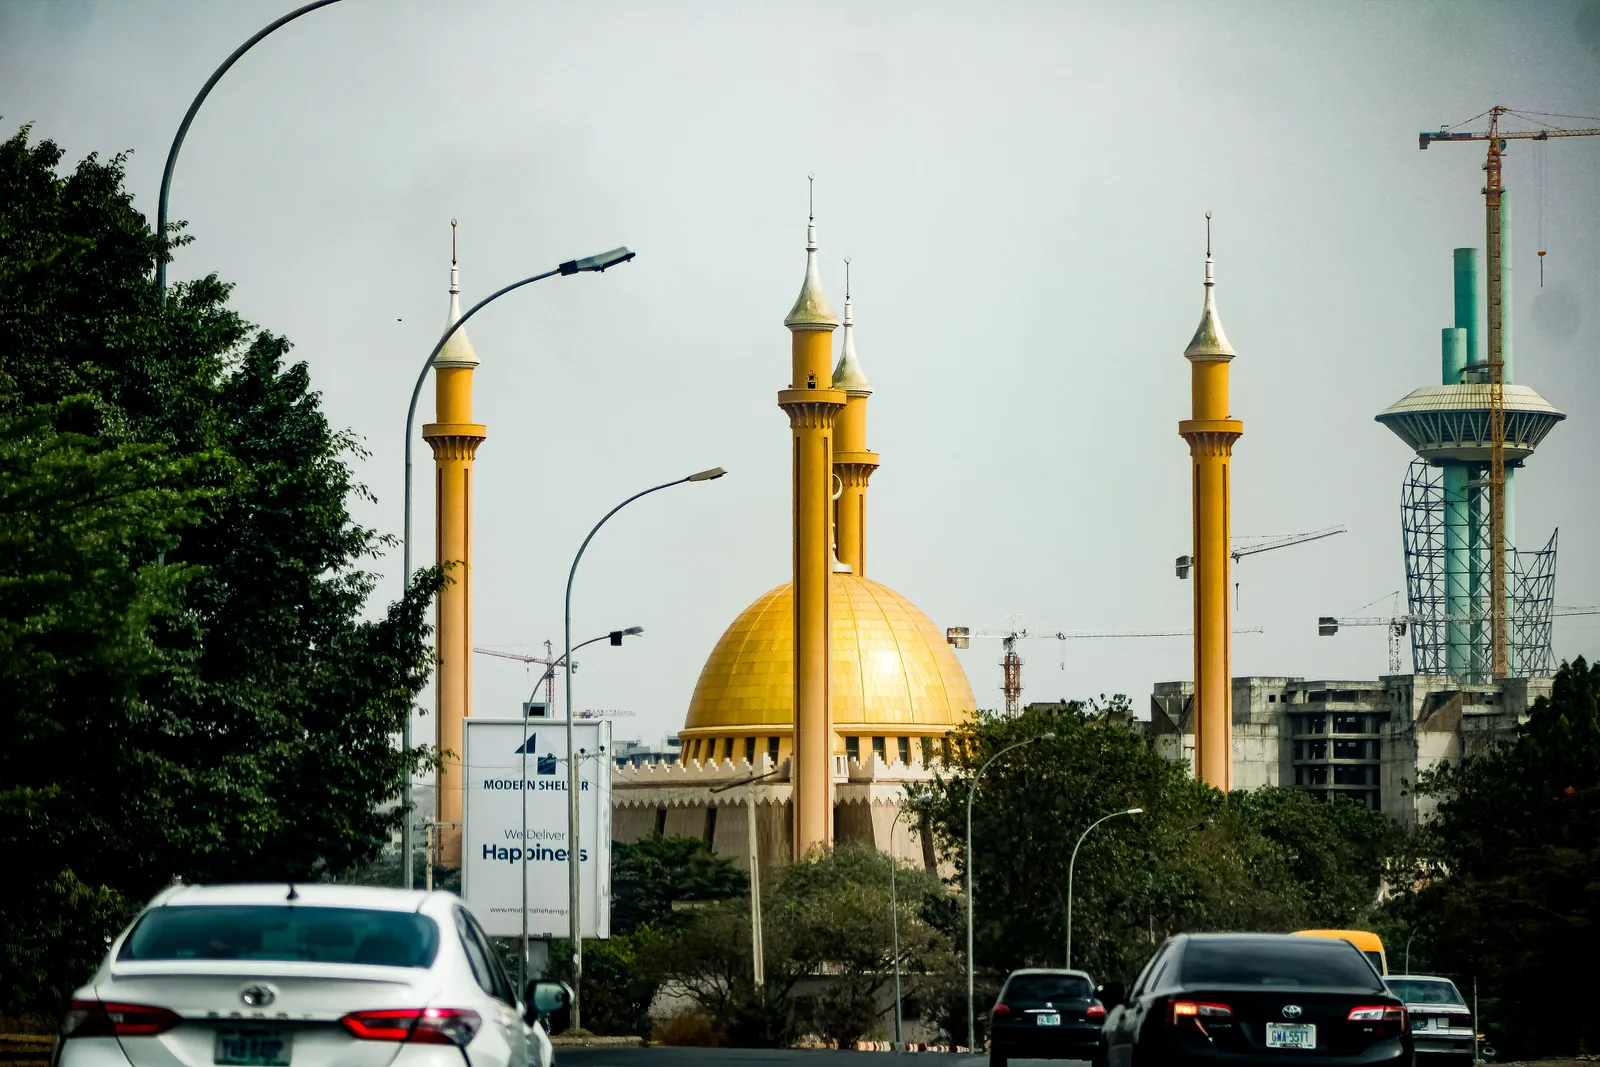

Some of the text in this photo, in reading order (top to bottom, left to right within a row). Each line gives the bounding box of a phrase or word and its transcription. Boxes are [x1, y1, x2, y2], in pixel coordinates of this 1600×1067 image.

[539, 780, 589, 791] SHELR
[504, 829, 566, 841] We Deliver
